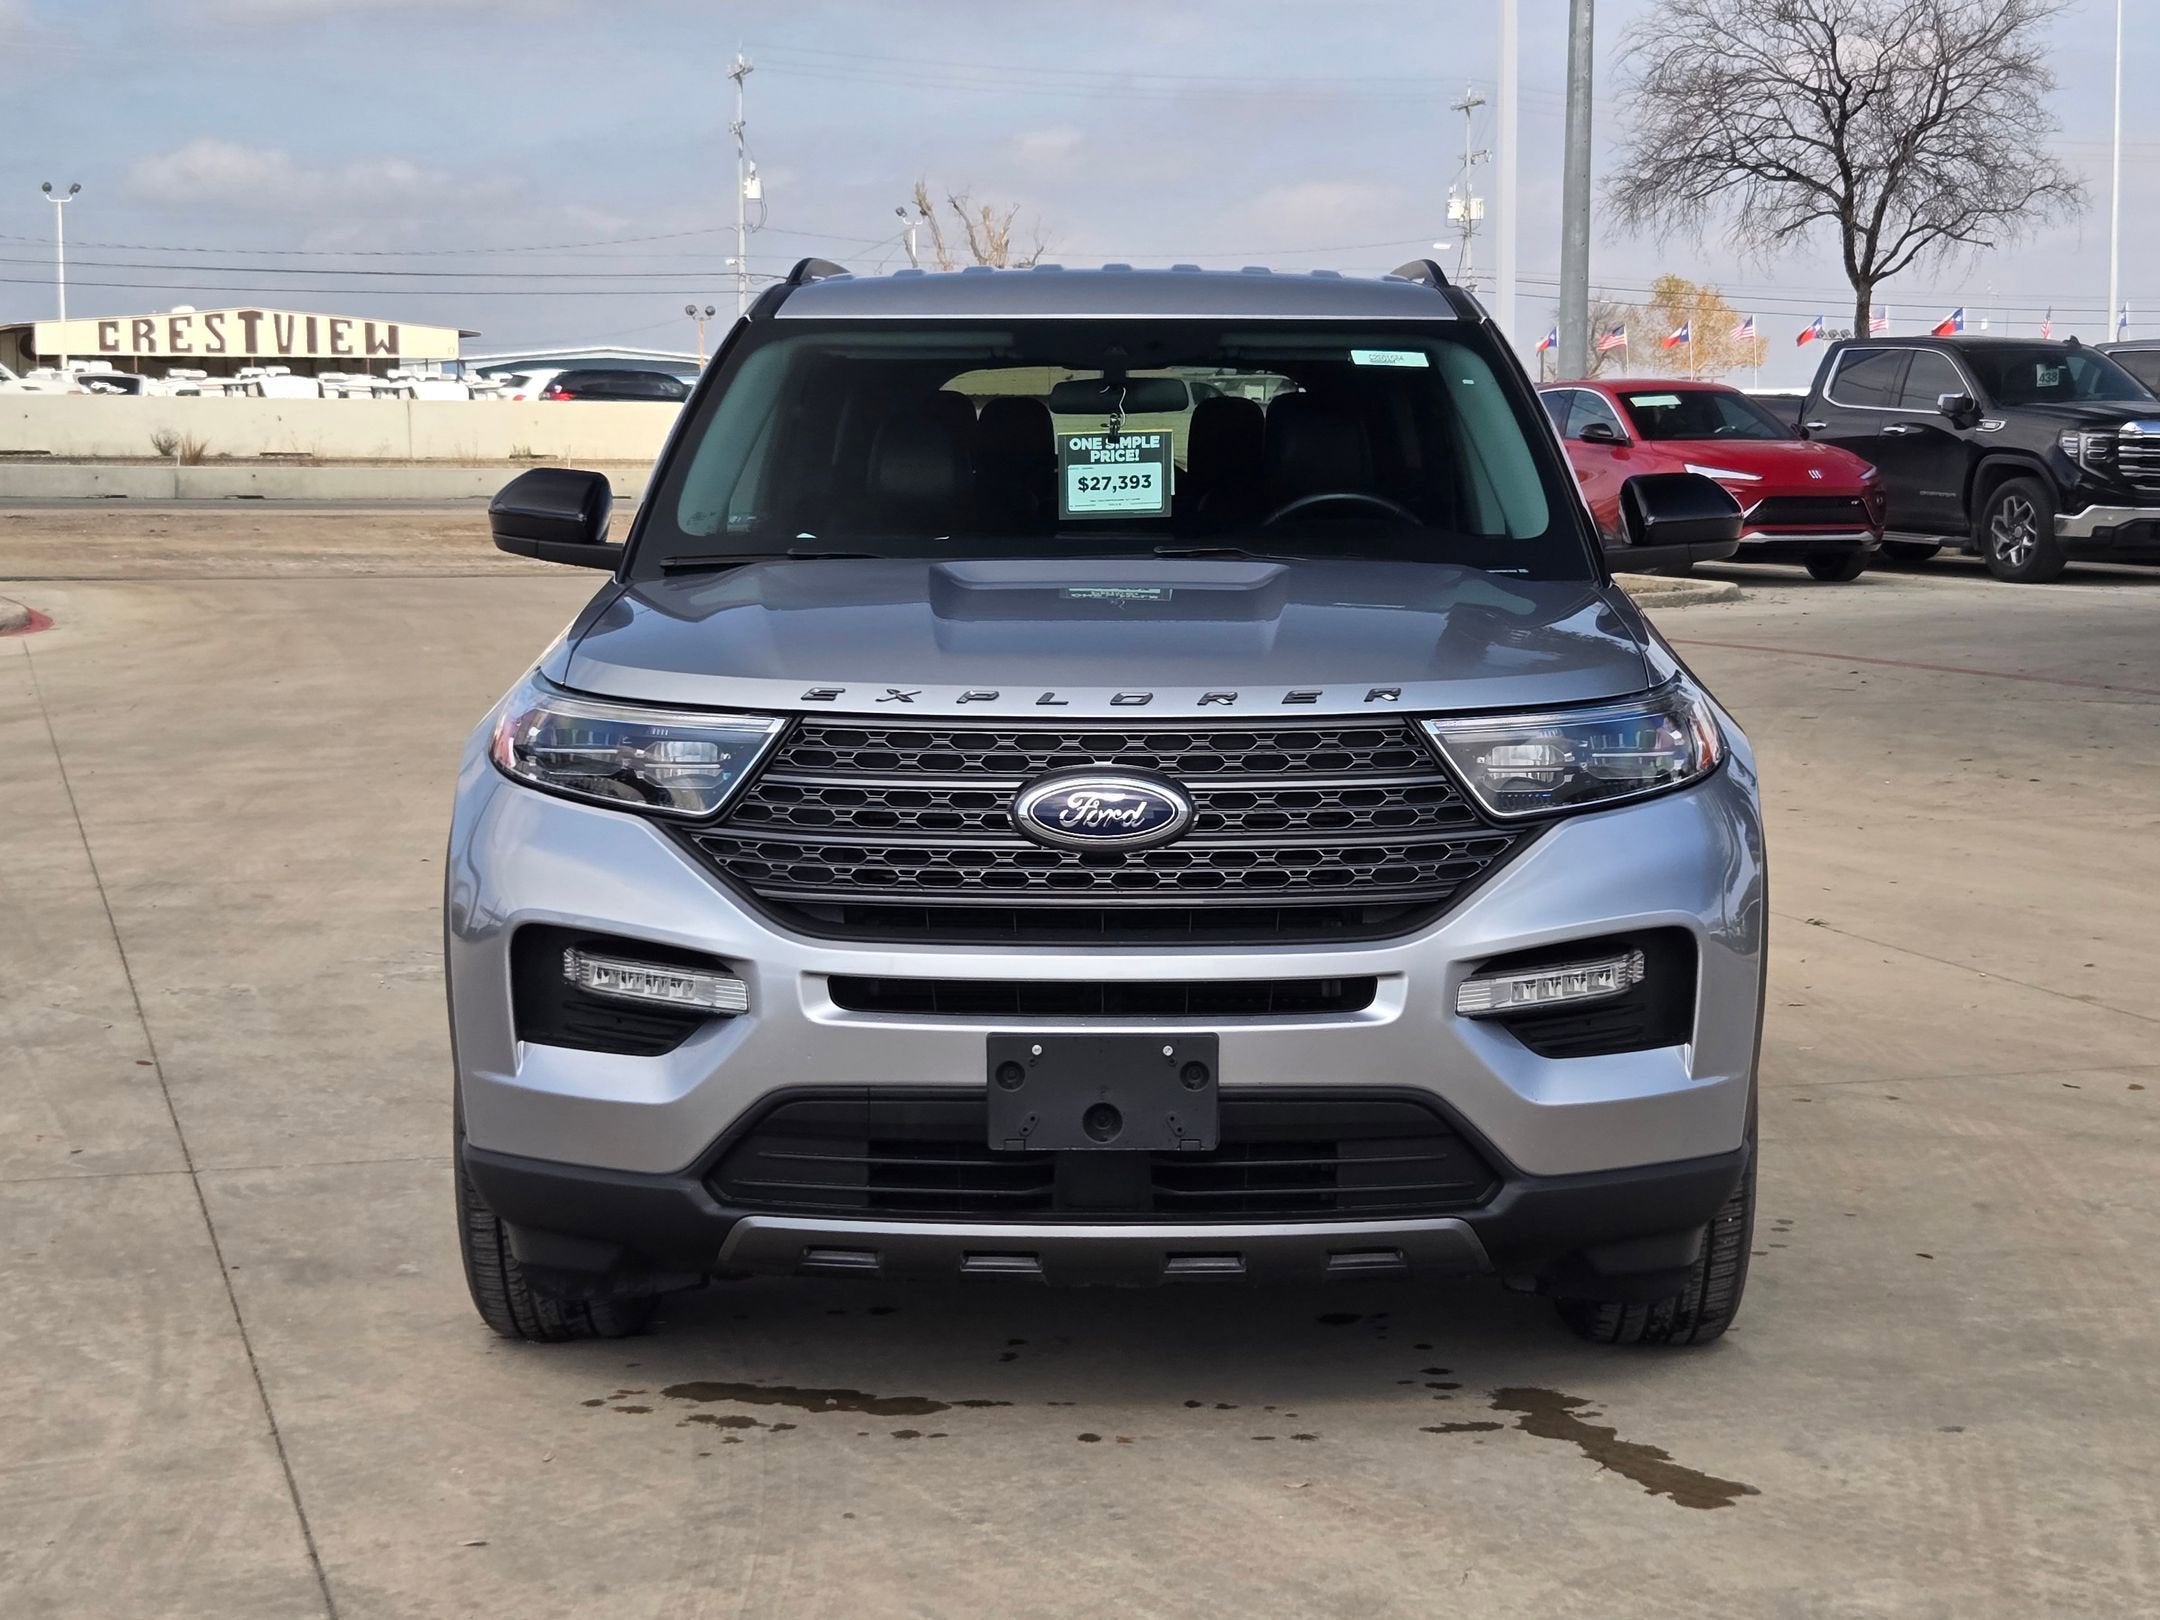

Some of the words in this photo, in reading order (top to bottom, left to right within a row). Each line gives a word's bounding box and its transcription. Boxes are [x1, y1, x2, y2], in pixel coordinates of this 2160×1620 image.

[98, 310, 400, 355] CRESTVIEW
[2039, 371, 2058, 383] 438
[1069, 437, 1102, 451] ONE
[1090, 449, 1140, 463] PRICE!
[1077, 474, 1152, 493] $27,393
[800, 687, 1402, 707] EXPLORER
[1059, 791, 1147, 828] Ford
